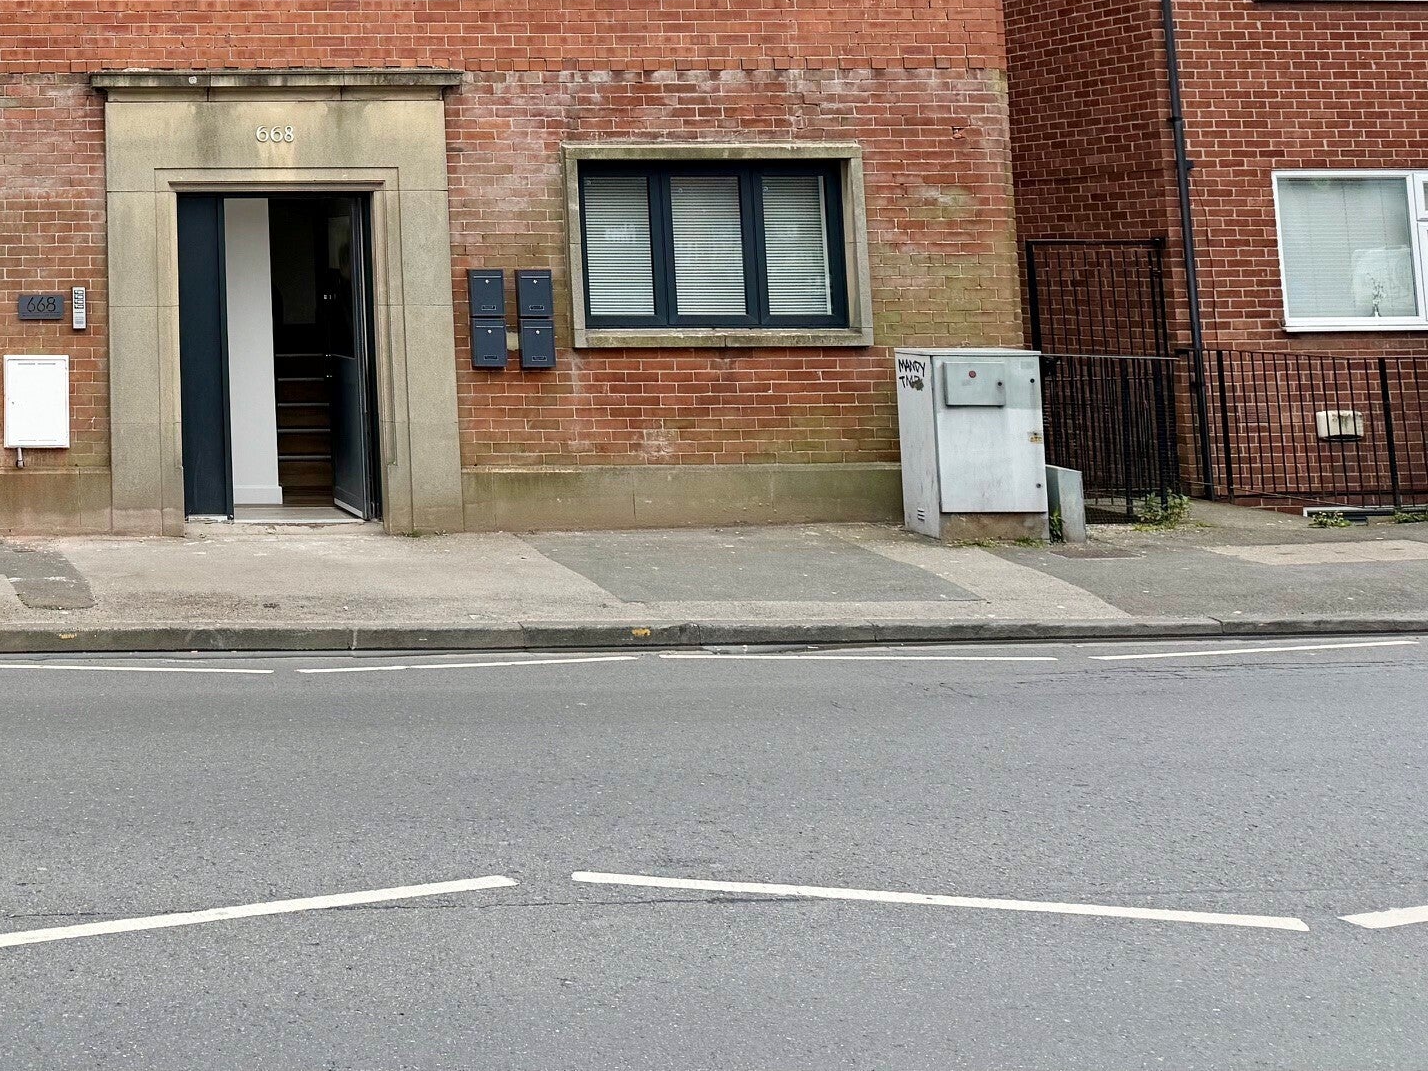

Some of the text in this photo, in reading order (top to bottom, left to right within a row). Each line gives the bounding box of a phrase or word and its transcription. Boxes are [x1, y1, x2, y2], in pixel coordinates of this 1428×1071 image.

[256, 125, 294, 143] 668
[27, 296, 56, 313] 668
[898, 359, 926, 377] MANDY
